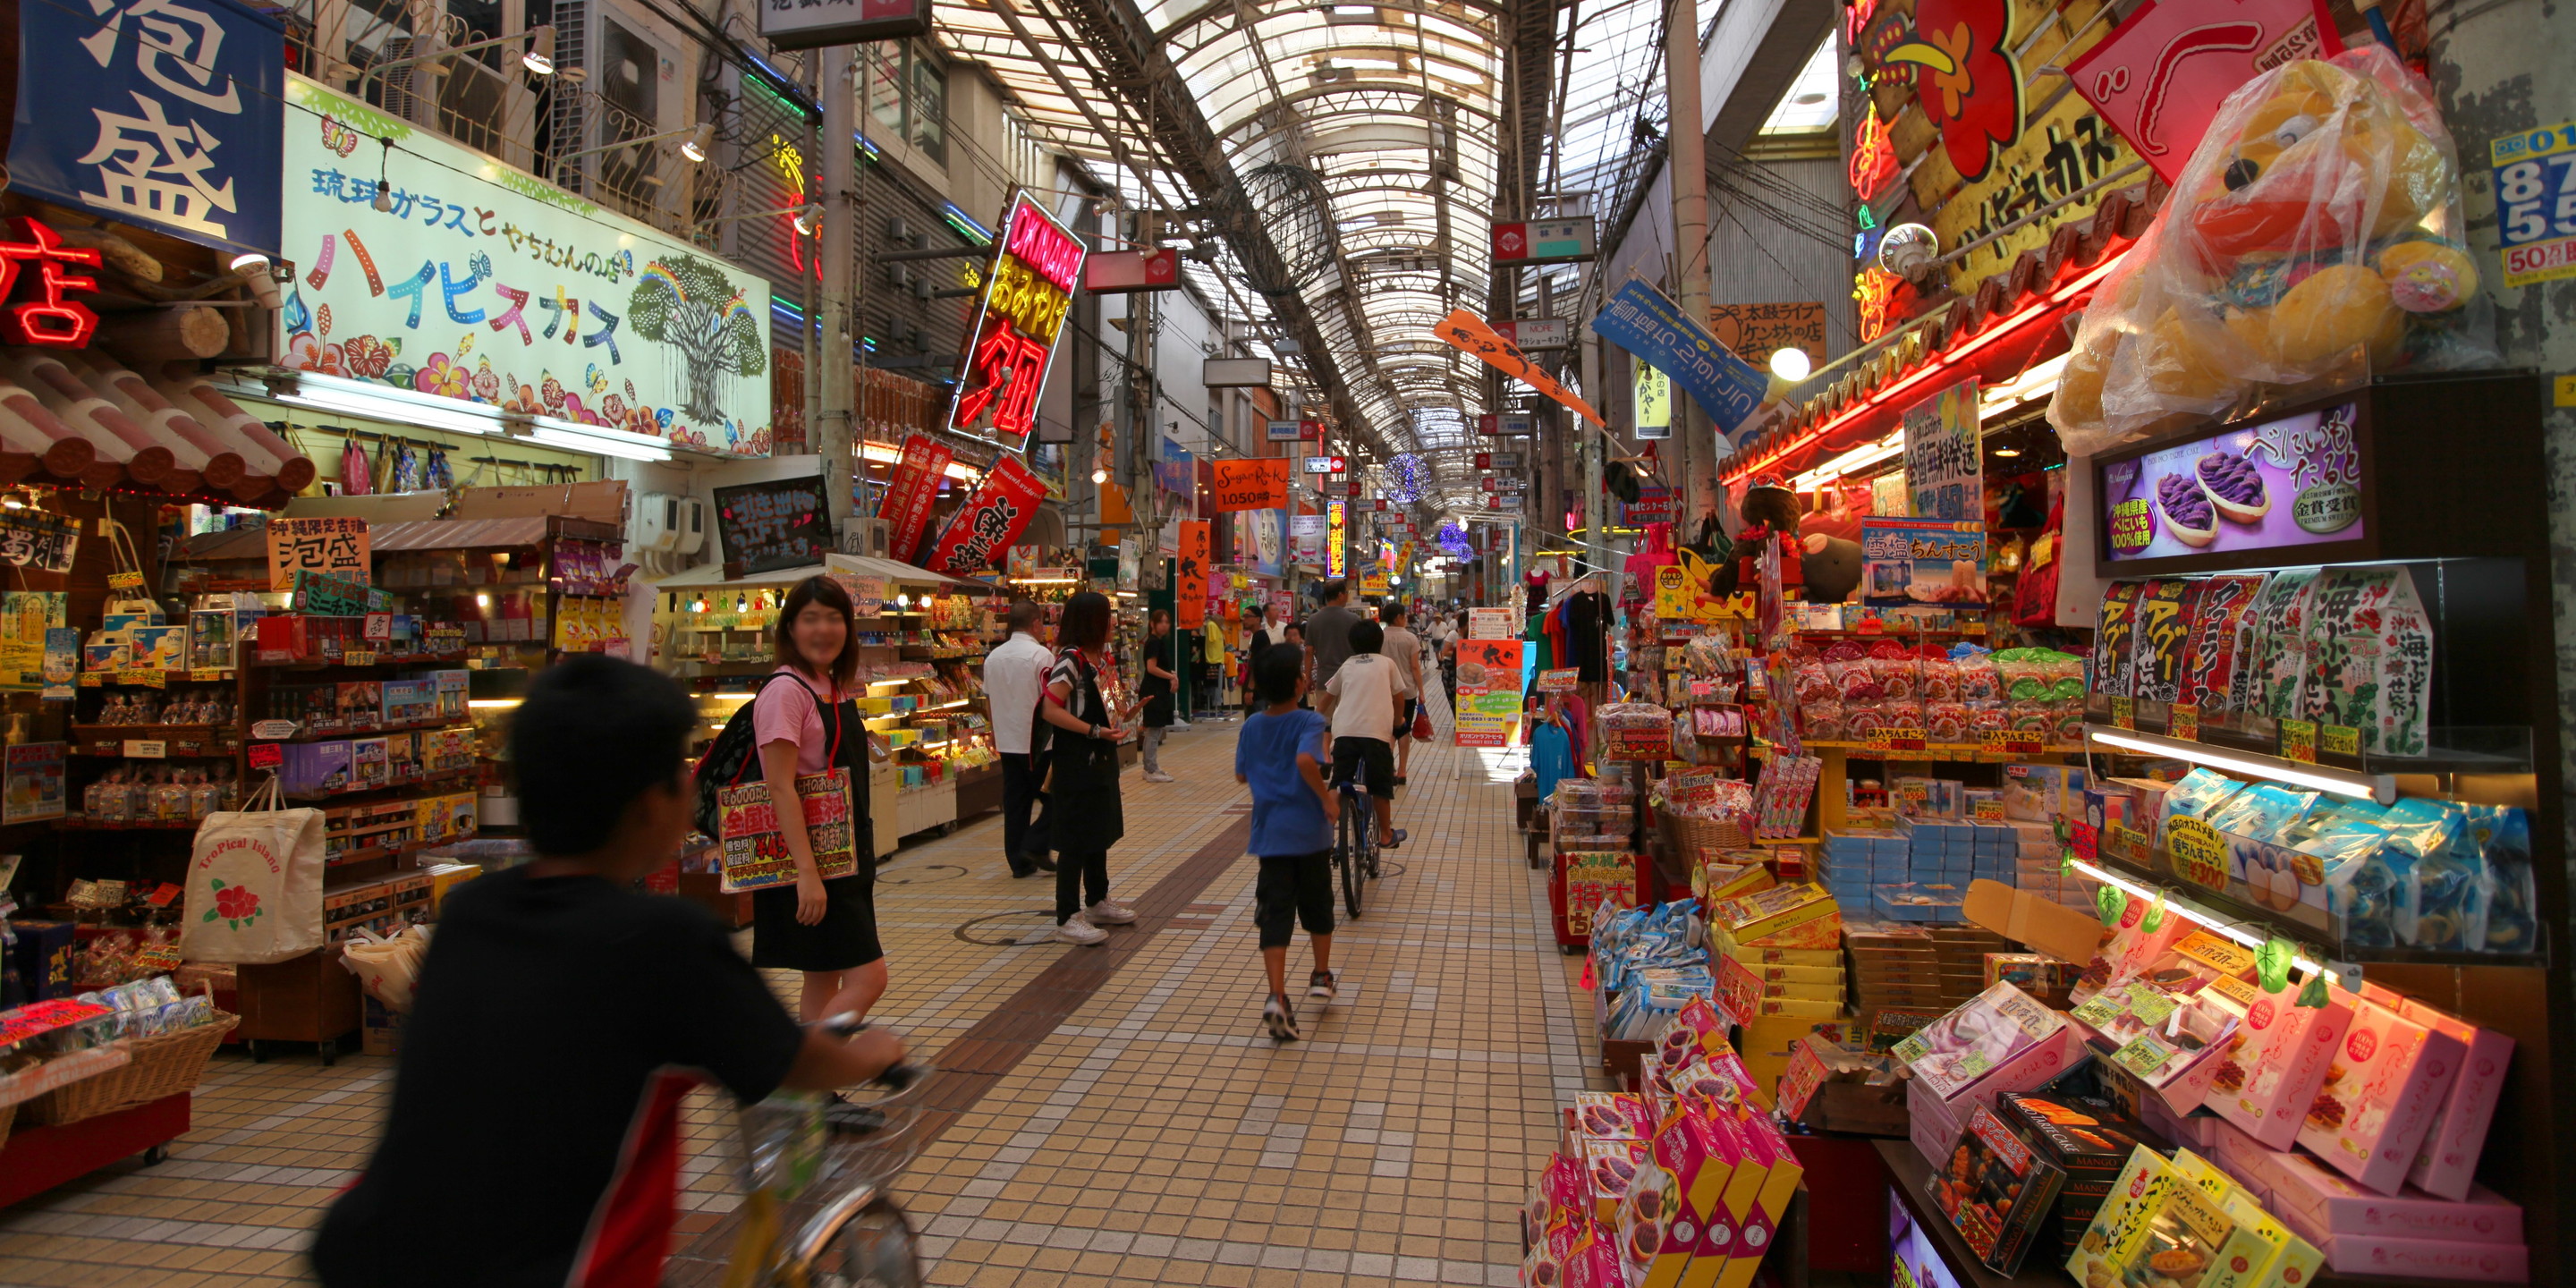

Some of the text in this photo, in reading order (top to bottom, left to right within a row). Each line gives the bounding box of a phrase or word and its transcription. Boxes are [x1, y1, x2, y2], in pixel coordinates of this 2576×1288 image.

[79, 0, 242, 239] 泡盛
[1956, 114, 2121, 272] ハイビスカス
[1011, 204, 1083, 293] OKINAWA
[306, 228, 622, 365] ハイビスカス
[1744, 303, 1826, 321] 太鼓ライブ
[1530, 324, 1554, 333] MORE
[1603, 315, 1666, 356] YUKISHIO
[1743, 321, 1823, 342] ケン坊の店
[1610, 298, 1752, 413] 雪塩ちんすこう
[2243, 409, 2353, 462] べにいも
[1906, 434, 1979, 487] 全国無料発送
[1217, 465, 1286, 489] Sugar Rock
[2113, 499, 2148, 519] 沖縄県産
[2295, 495, 2359, 518] 金賞受賞
[270, 518, 368, 537] 沖縄限定古酒
[2113, 514, 2148, 532] べにいも
[2300, 515, 2327, 525] PREMIUM
[1865, 536, 1982, 562] 雪塩ちんすこう
[2111, 530, 2151, 549] 100%使用
[278, 533, 361, 569] 泡盛
[2352, 580, 2390, 634] 沖縄
[2103, 600, 2130, 675] アグー
[2147, 600, 2189, 682] アグー
[2193, 580, 2242, 711] タコライス
[1867, 728, 1927, 739] 袋入ちんすこう
[2118, 716, 2133, 732] ¥580
[2178, 726, 2197, 740] ¥580
[1867, 741, 1891, 750] ¥350
[1982, 731, 2044, 741] 袋入ちんすこう
[1626, 741, 1670, 753] ¥90
[1982, 744, 2006, 753] ¥350
[2291, 744, 2315, 761] ¥580
[1903, 792, 1926, 801] ¥550
[1977, 811, 2003, 820] ¥300
[724, 839, 750, 853] 梱包料
[755, 834, 792, 860] ¥45
[2172, 837, 2222, 867] 塩ちんすこう
[725, 852, 751, 868] 保証料
[1580, 852, 1616, 868] 沖縄
[2190, 861, 2224, 893] ¥300
[1570, 881, 1634, 911] 特大
[1569, 911, 1596, 935] ち
[2351, 1040, 2371, 1053] 沖縄県産
[2354, 1031, 2376, 1046] 100%
[2004, 1091, 2080, 1154] MANGO TARTE CAKE
[1984, 1120, 2029, 1165] マンゴーたると
[2076, 1156, 2117, 1167] MANGO
